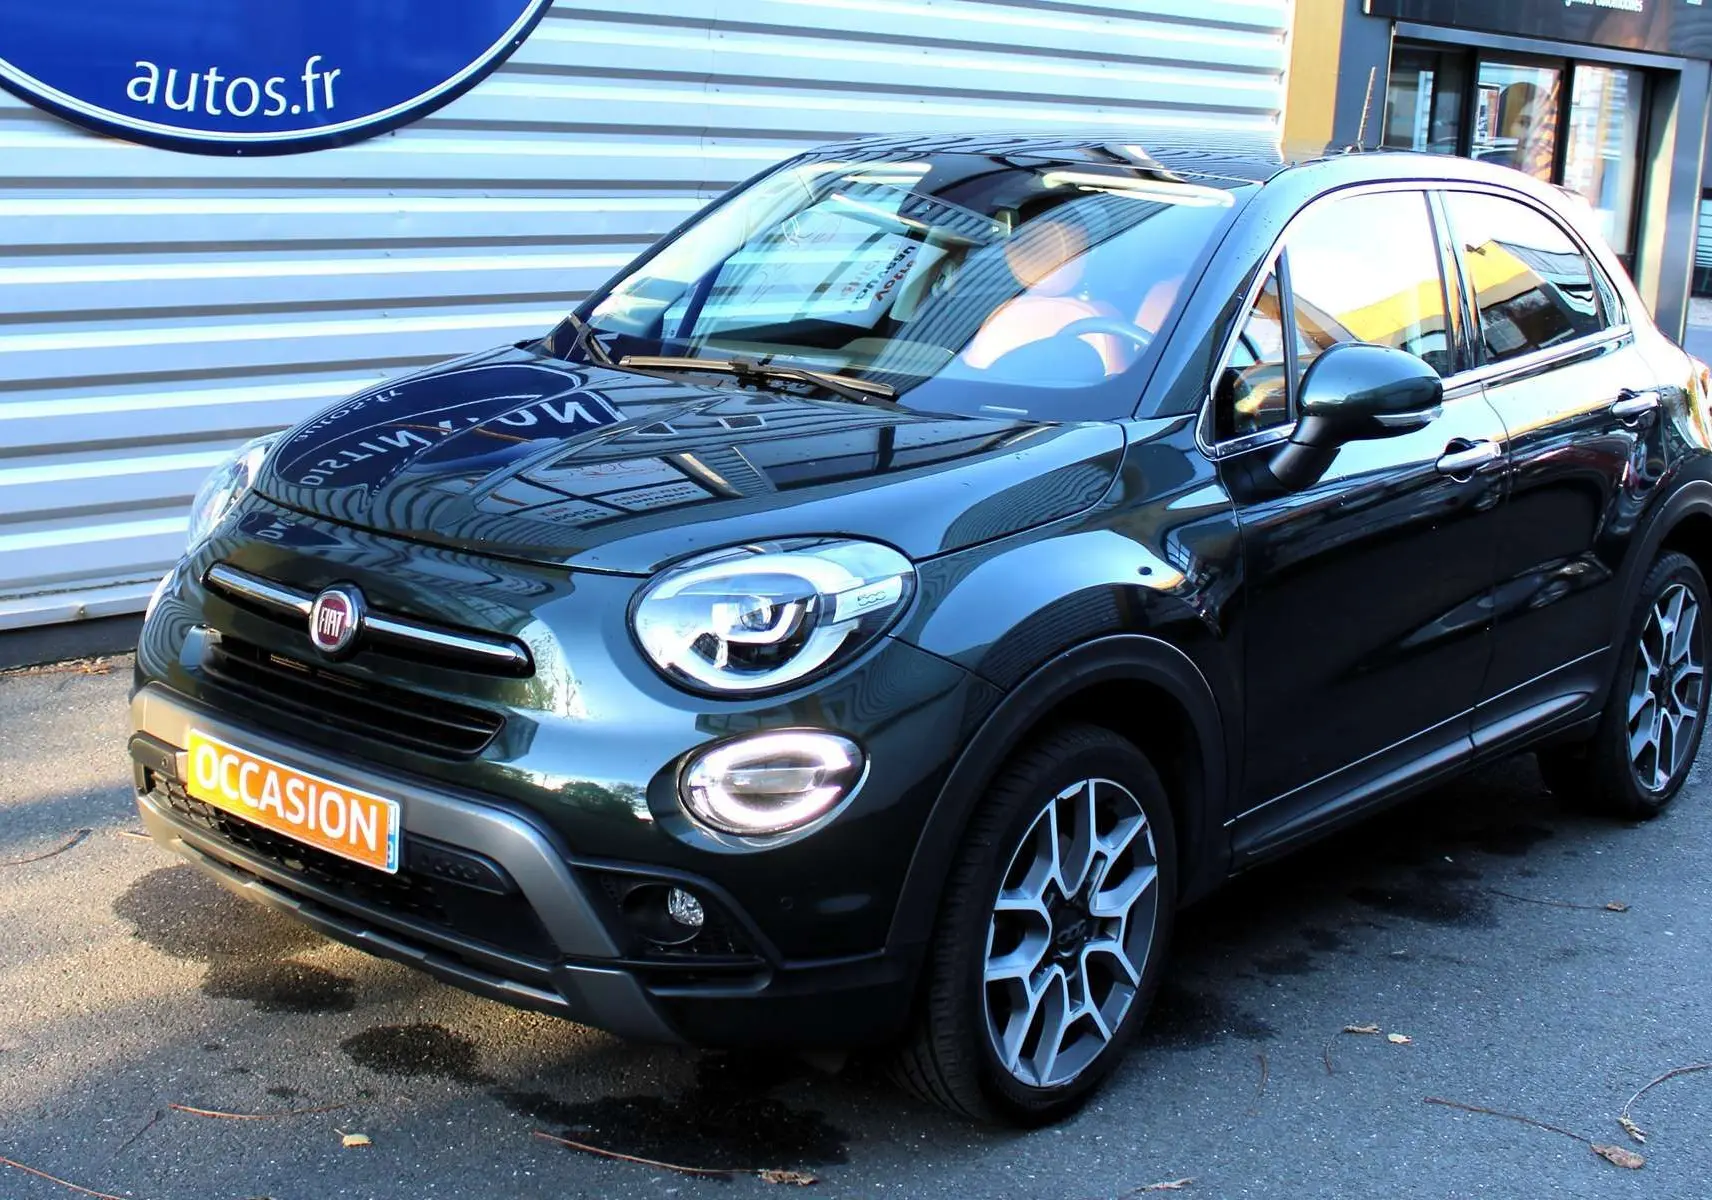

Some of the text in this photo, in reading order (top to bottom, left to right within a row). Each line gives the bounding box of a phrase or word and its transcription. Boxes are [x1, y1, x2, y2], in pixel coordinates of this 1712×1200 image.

[126, 55, 341, 117] autos.fr
[319, 607, 345, 638] FIAT
[195, 746, 377, 851] OCCASION
